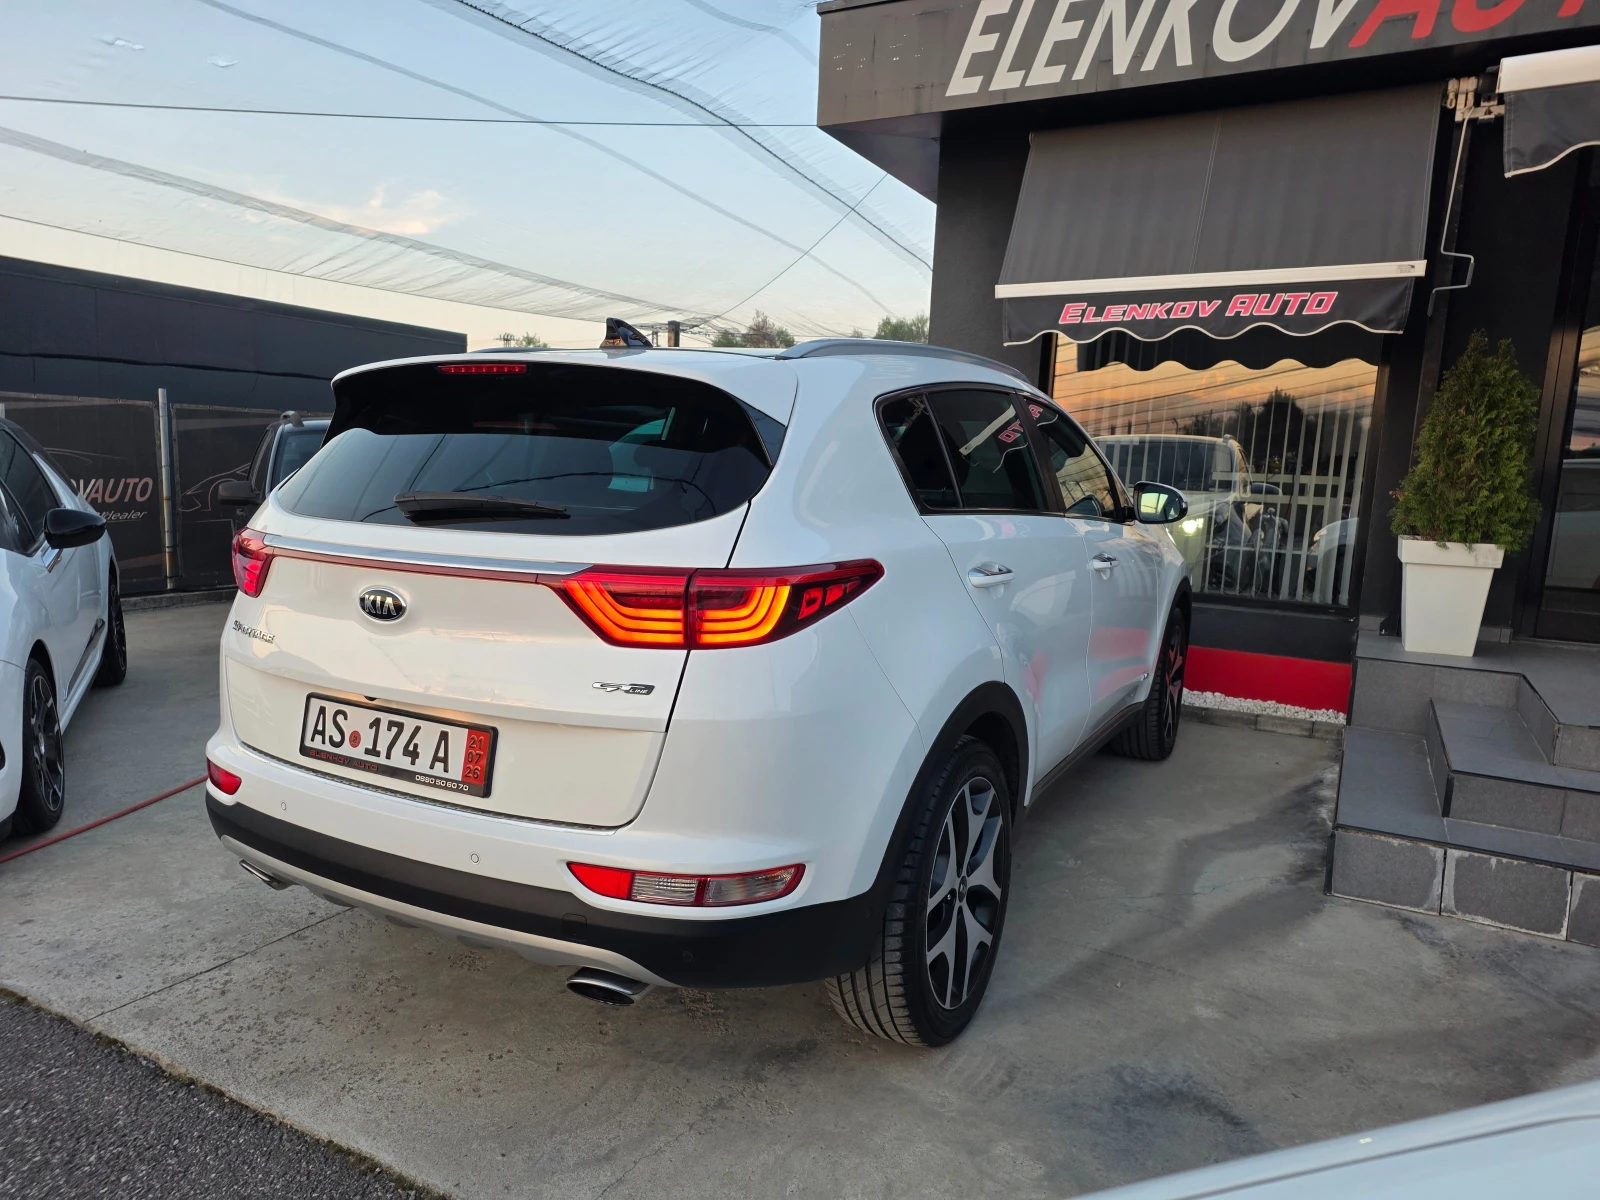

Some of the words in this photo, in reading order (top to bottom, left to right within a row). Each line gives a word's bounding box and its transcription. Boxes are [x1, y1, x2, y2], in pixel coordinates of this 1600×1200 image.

[1058, 300, 1221, 325] ELENKOV
[1225, 291, 1338, 317] AUTO
[70, 477, 153, 503] VAUTO
[364, 594, 397, 616] KIA
[310, 705, 348, 749] AS
[363, 716, 422, 766] 174
[429, 729, 450, 773] A
[469, 735, 484, 750] 21
[467, 750, 483, 764] 07
[352, 760, 379, 773] AUTO
[465, 765, 481, 779] 26
